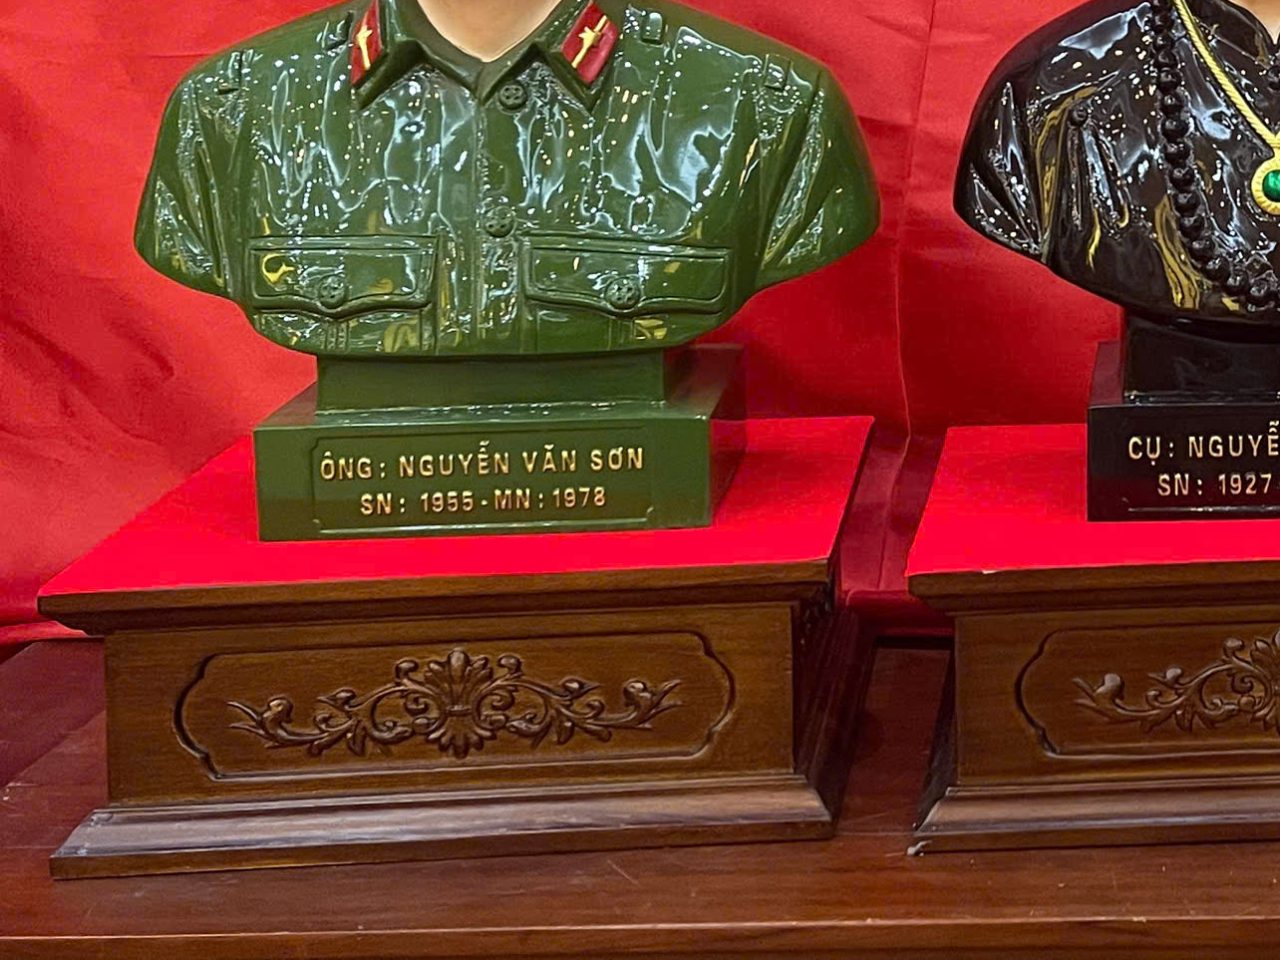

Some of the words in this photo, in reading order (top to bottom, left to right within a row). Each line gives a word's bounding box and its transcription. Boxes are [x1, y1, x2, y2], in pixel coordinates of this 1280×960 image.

[400, 440, 510, 477] NGUYỄN
[522, 444, 577, 474] VĂN
[590, 447, 644, 471] SƠN
[1218, 473, 1272, 495] 1927
[420, 491, 474, 513] 1955
[552, 487, 606, 509] 1978
